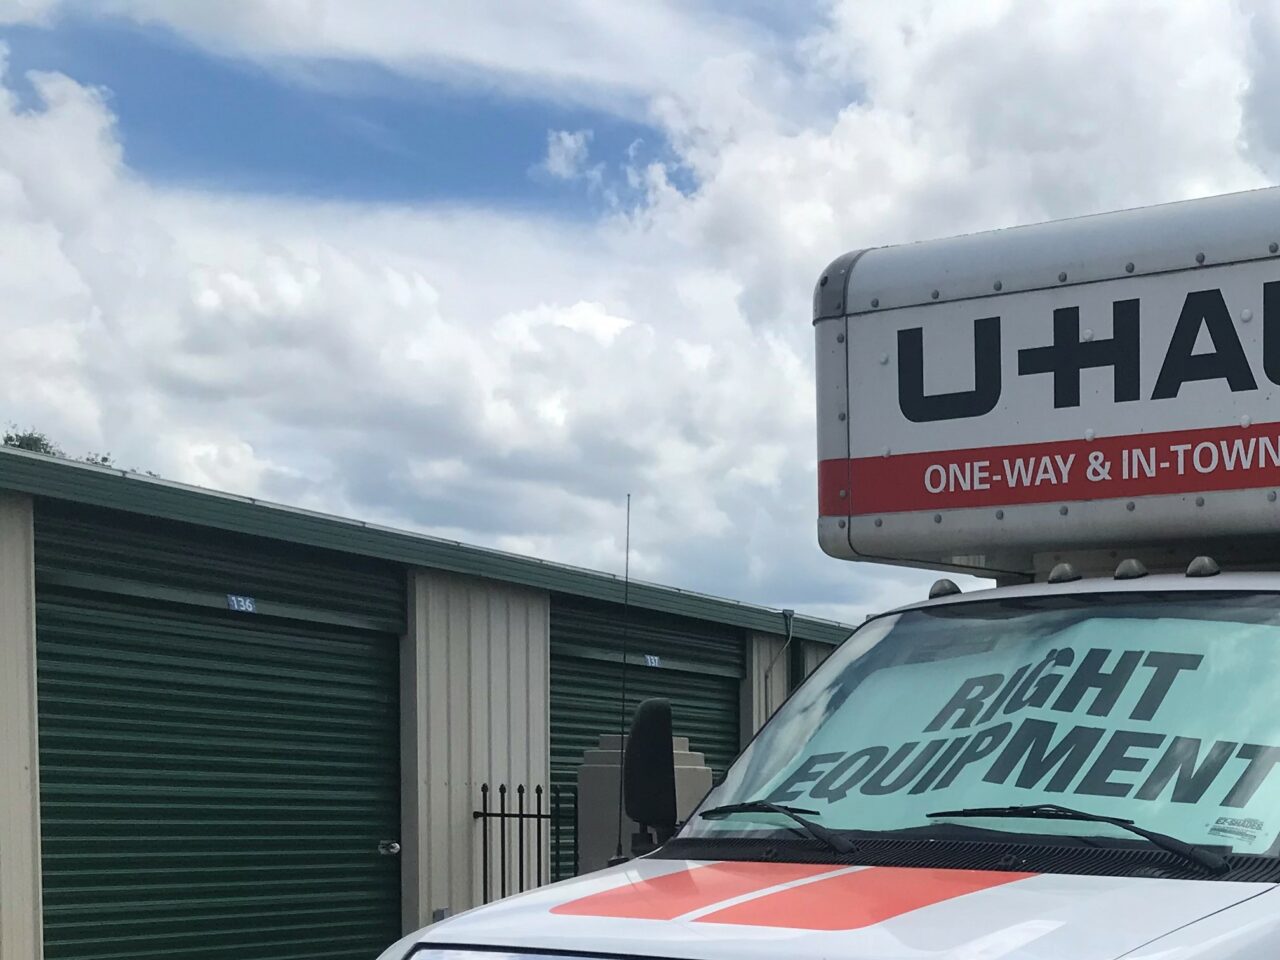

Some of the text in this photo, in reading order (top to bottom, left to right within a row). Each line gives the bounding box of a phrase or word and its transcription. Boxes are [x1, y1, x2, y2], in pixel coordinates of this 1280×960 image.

[924, 453, 1077, 495] ONE-WAY
[1087, 449, 1112, 482] &
[231, 596, 253, 611] 136
[923, 647, 1205, 735] RIGHT
